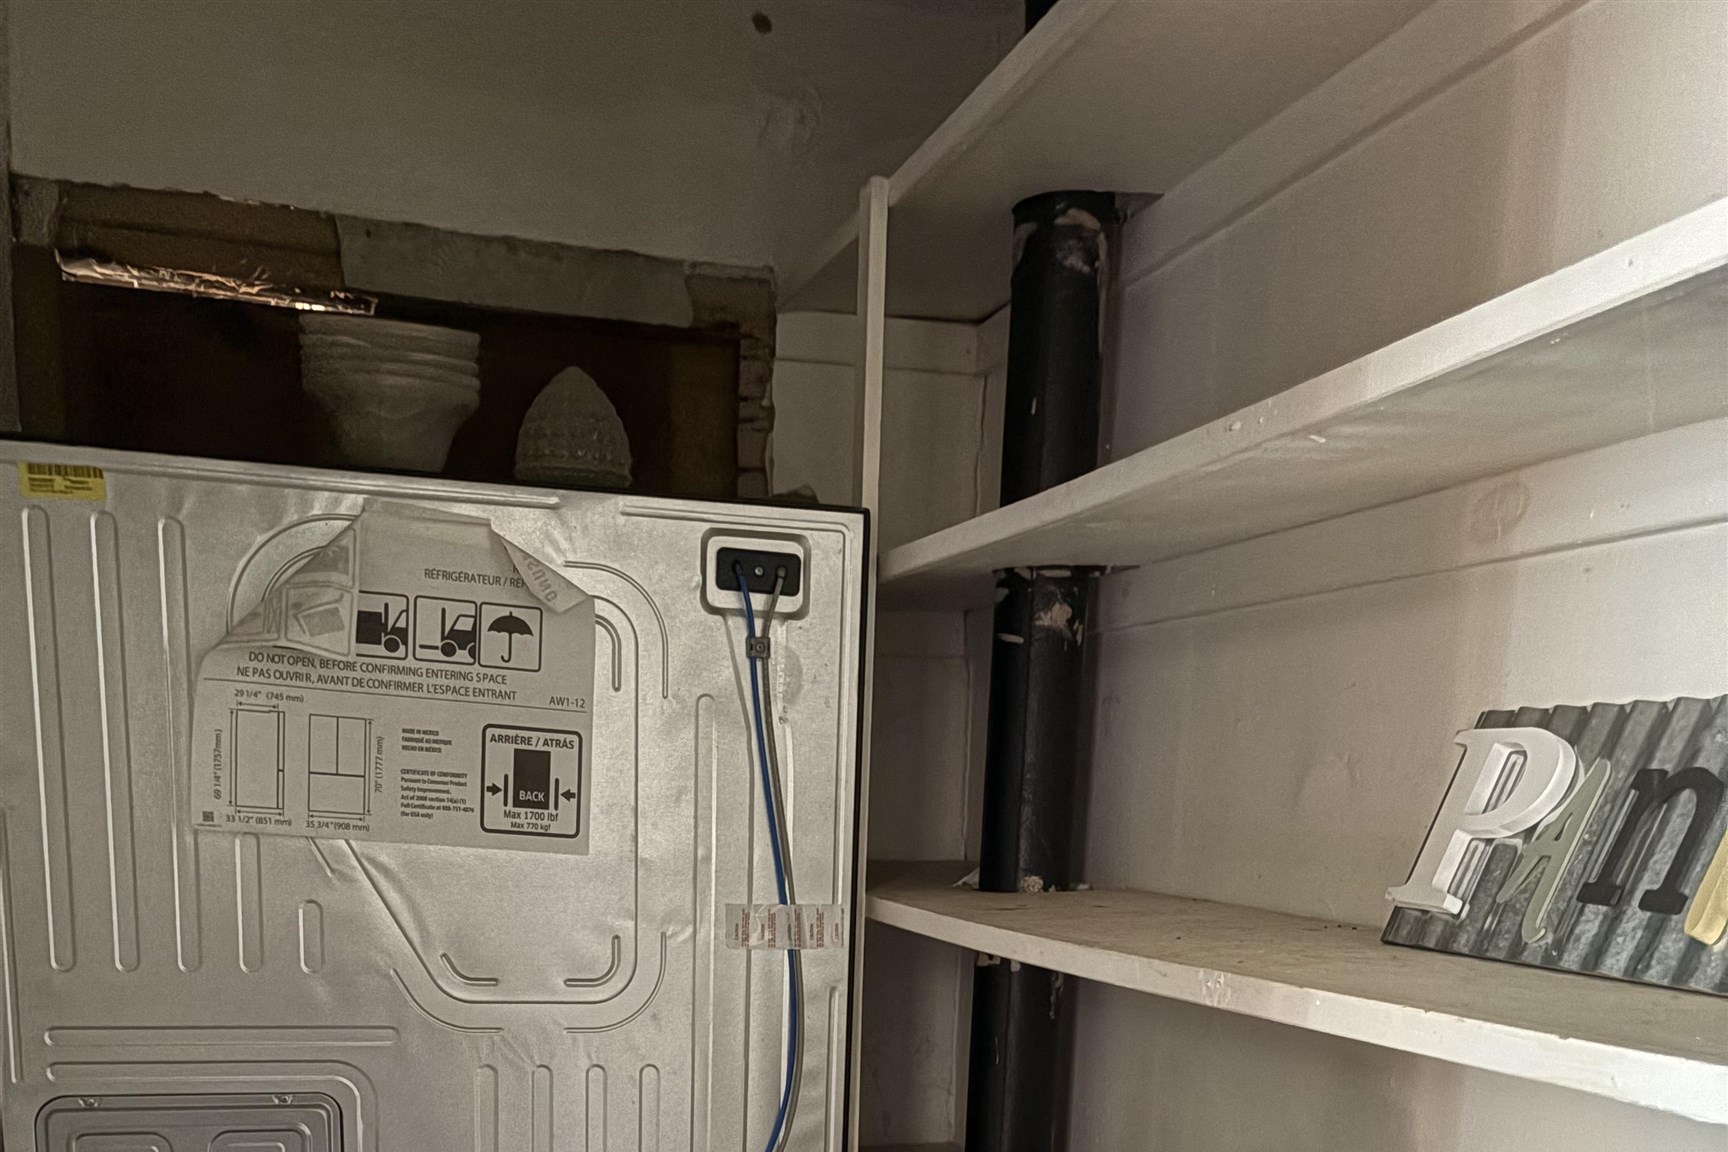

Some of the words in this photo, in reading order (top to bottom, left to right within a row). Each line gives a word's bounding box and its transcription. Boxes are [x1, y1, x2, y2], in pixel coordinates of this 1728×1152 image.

[424, 567, 501, 587] RÉFRIGÉRATEUR
[249, 651, 265, 663] DO
[267, 653, 287, 665] NOT
[287, 655, 317, 669] OPEN,
[319, 659, 358, 672] BEFORE
[360, 662, 424, 678] CONFIRMING
[425, 668, 474, 682] ENTERING
[476, 672, 507, 685] SPACE
[236, 666, 250, 677] NE
[252, 667, 272, 679] PAS
[316, 674, 350, 687] AVANT
[351, 677, 365, 688] DE
[366, 678, 424, 693] CONFIRMER
[472, 688, 517, 701] ENTRANT
[549, 696, 586, 709] AW1-12
[489, 733, 533, 746] ARRIÈRE
[542, 738, 575, 749] ATRÁS
[519, 790, 545, 802] BACK
[503, 809, 522, 820] Max
[524, 811, 546, 821] 1700
[547, 812, 559, 822] lbf
[510, 821, 525, 829] Max
[526, 822, 539, 830] 770
[540, 823, 552, 832] kgf
